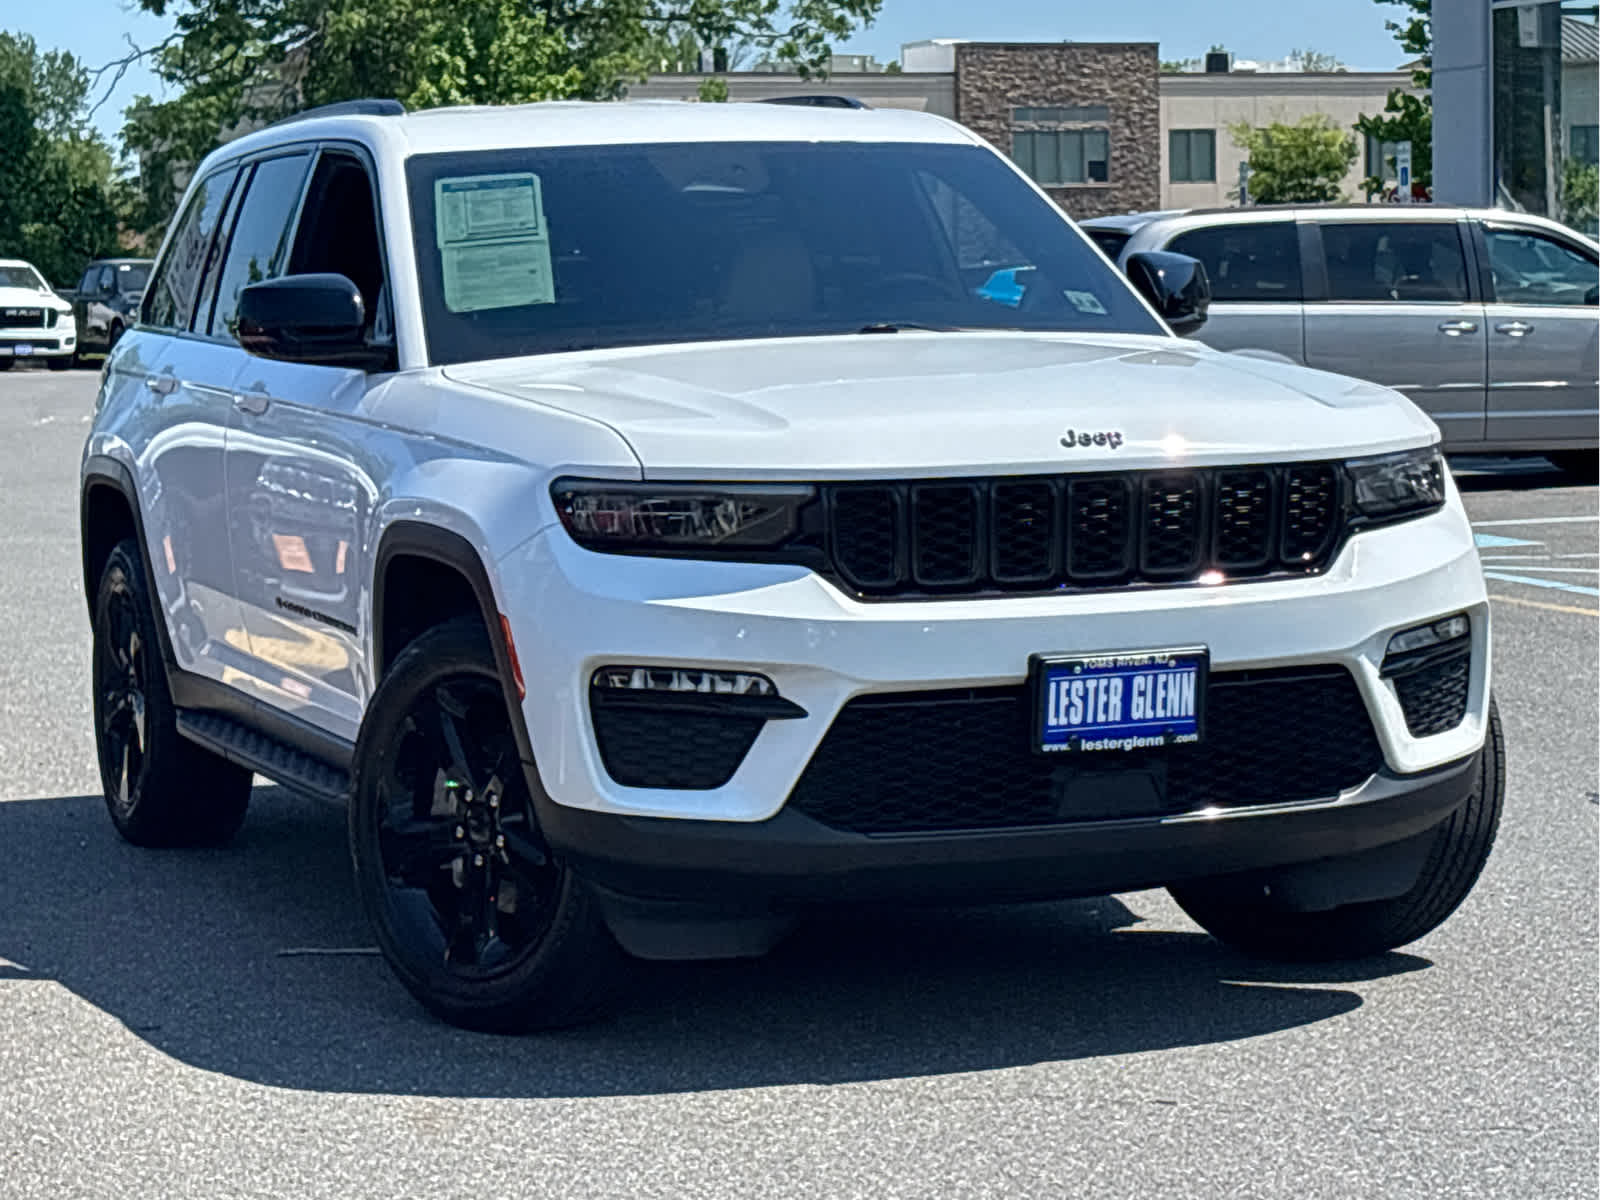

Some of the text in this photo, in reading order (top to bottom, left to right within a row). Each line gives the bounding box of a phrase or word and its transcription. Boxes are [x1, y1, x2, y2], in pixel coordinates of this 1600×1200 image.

[1060, 429, 1123, 450] Jeep
[1083, 658, 1114, 669] TOMS
[1047, 671, 1196, 726] LESTER GLENN
[1081, 735, 1164, 751] lesterglenn
